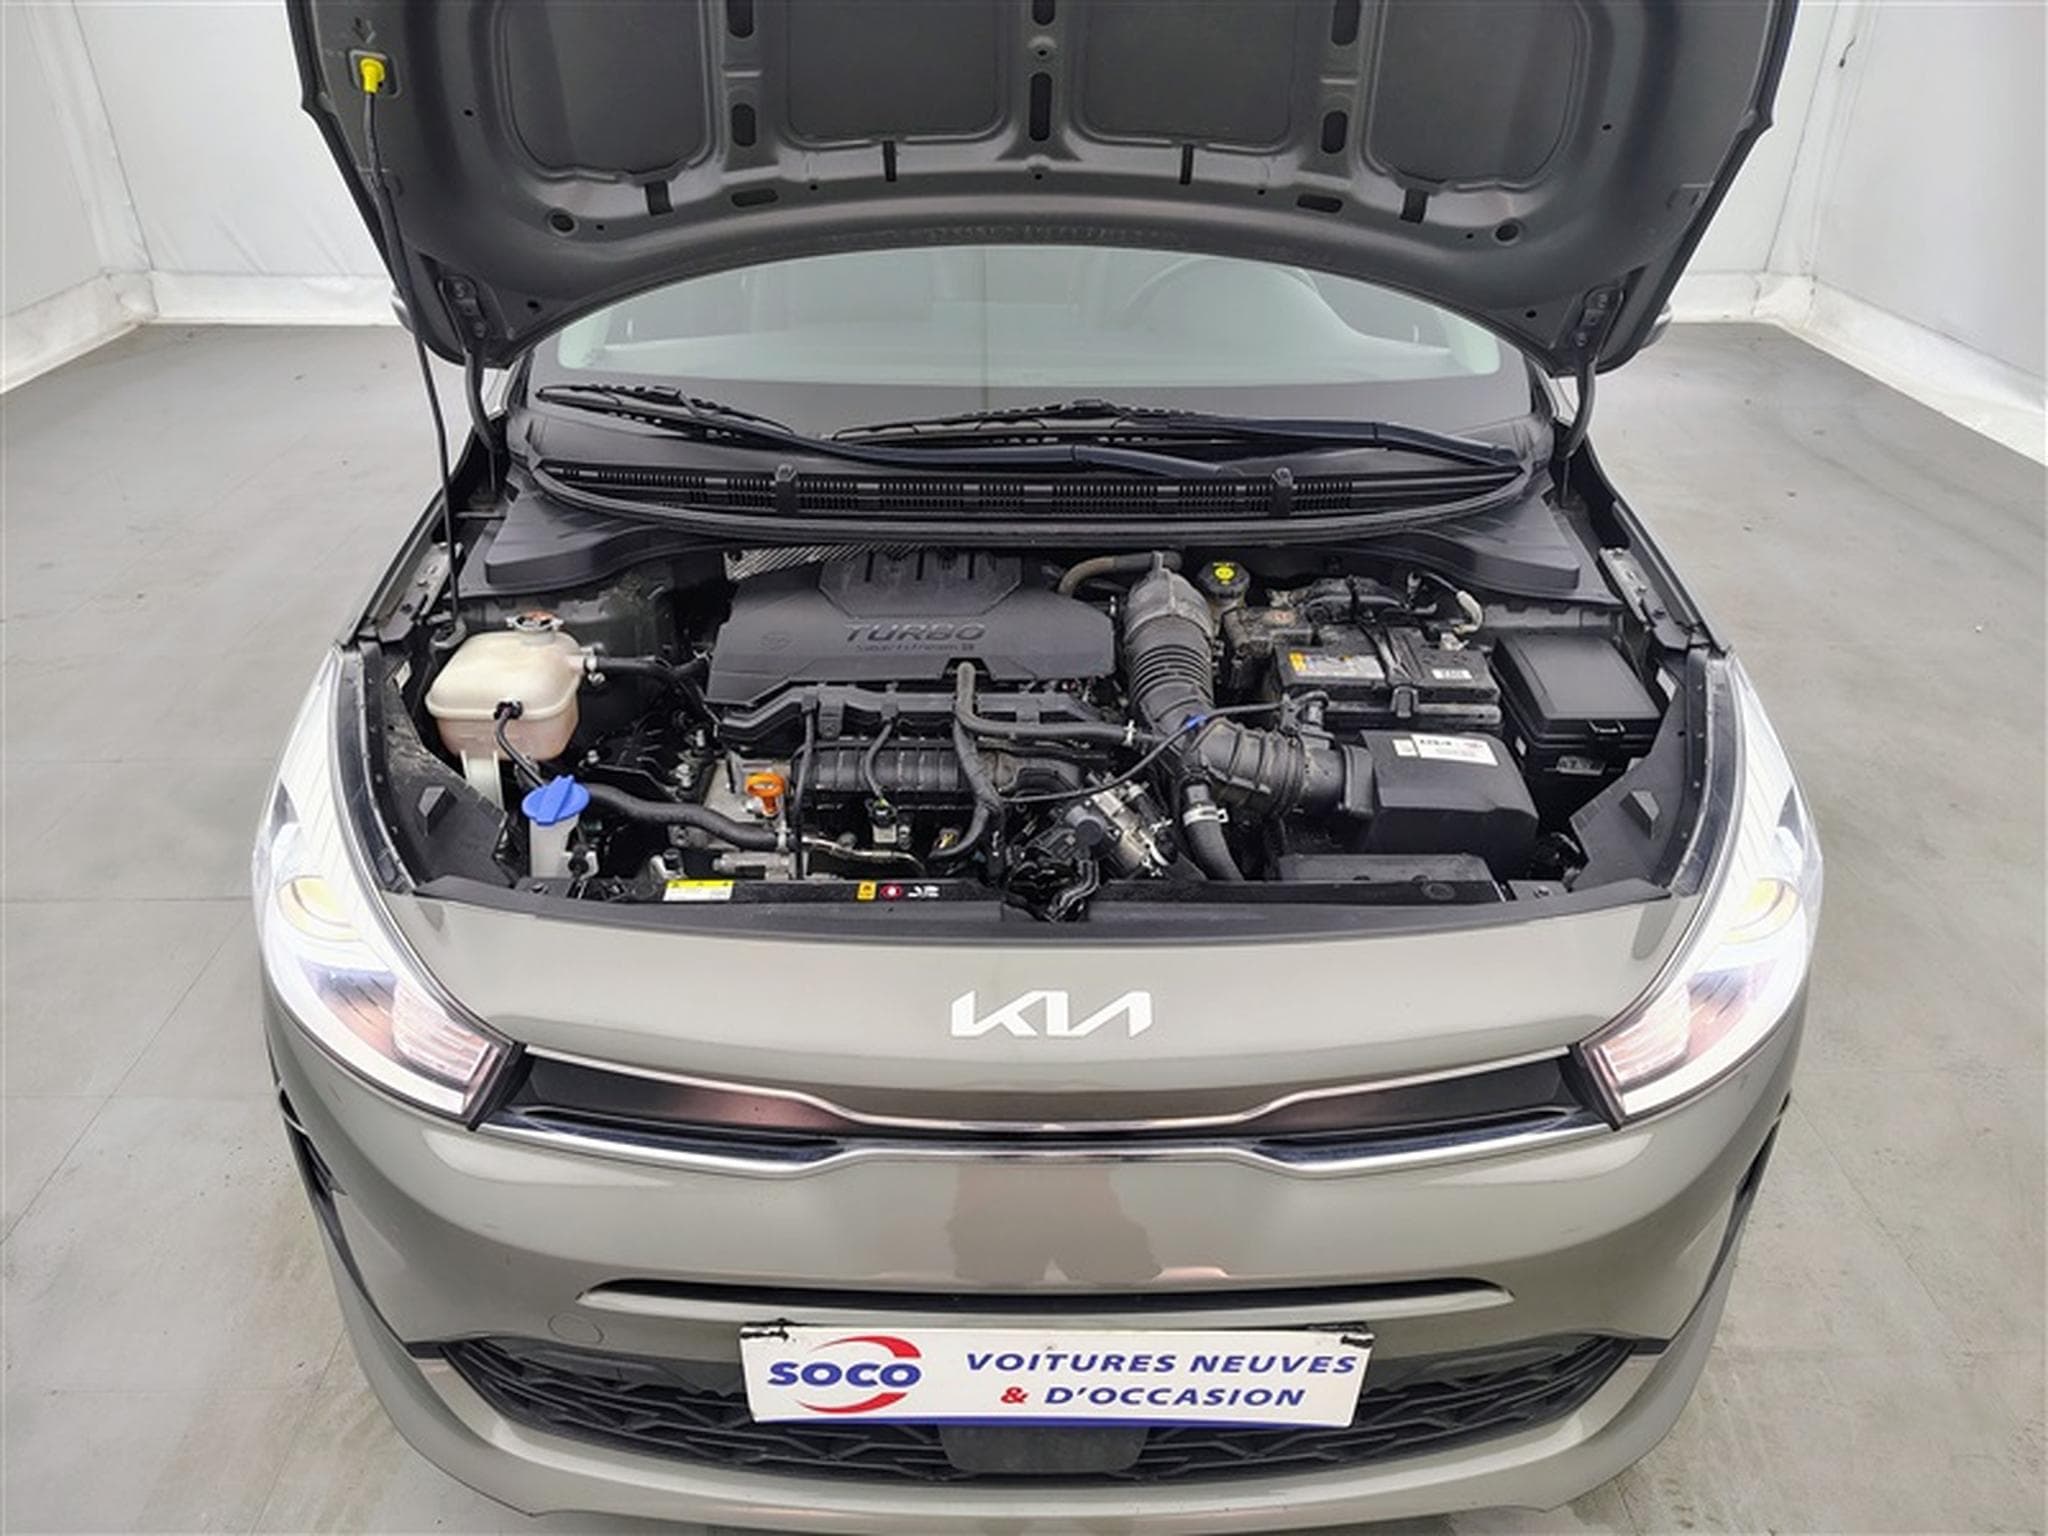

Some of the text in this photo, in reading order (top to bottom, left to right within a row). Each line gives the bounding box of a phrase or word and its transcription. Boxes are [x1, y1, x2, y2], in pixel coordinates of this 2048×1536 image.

[844, 623, 986, 642] TURBO
[951, 990, 1153, 1038] KIA
[966, 1352, 1358, 1374] VOITURES NEUVES
[768, 1361, 922, 1388] SOCO
[1000, 1386, 1306, 1406] & D'OCCASION
